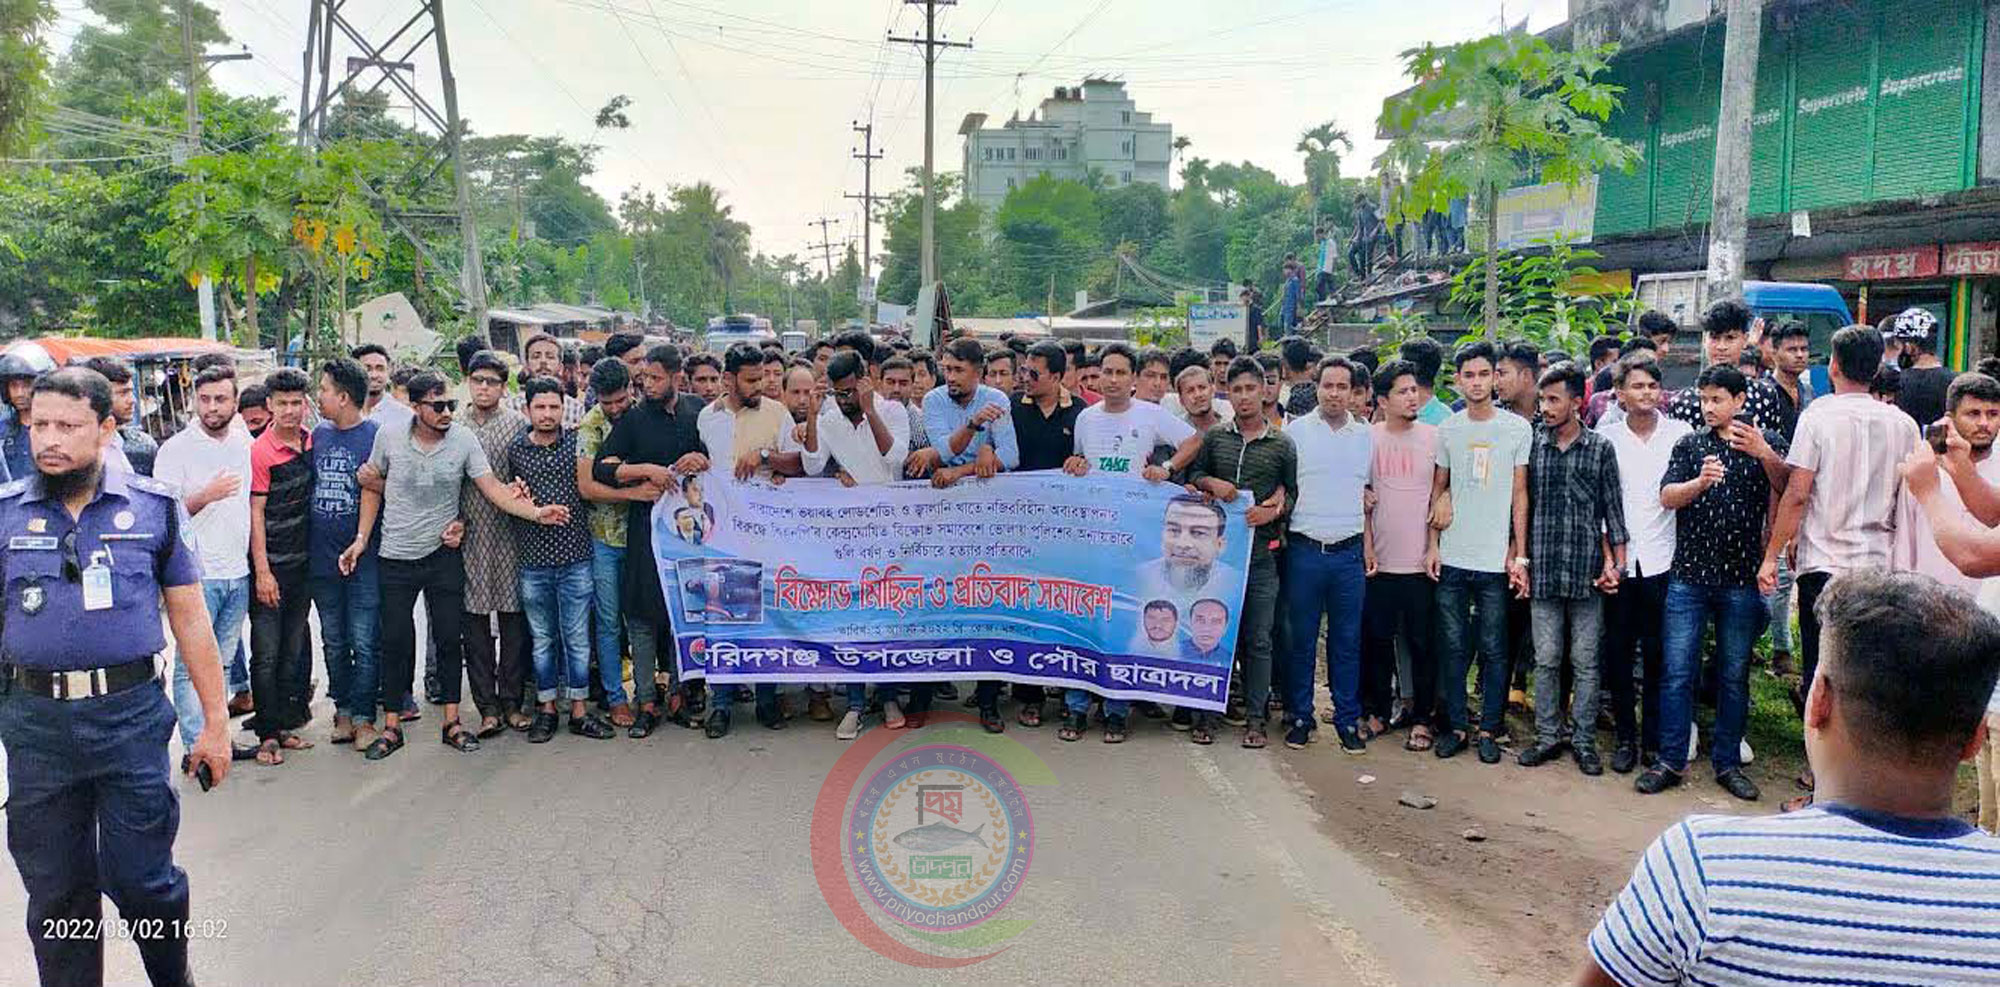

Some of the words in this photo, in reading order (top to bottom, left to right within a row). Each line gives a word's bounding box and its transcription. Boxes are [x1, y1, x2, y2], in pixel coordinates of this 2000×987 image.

[323, 459, 347, 471] LIFE
[774, 564, 852, 611] বিক্ষোভ
[859, 565, 924, 618] মিছিল
[929, 576, 947, 607] ও
[953, 561, 1033, 610] প্রতিবাদ
[1037, 576, 1112, 622] সমাবেশ
[833, 645, 976, 668] উপজেলা
[988, 647, 1015, 666] ও
[1029, 646, 1100, 678] পৌর
[1106, 663, 1224, 695] ছাত্রদল
